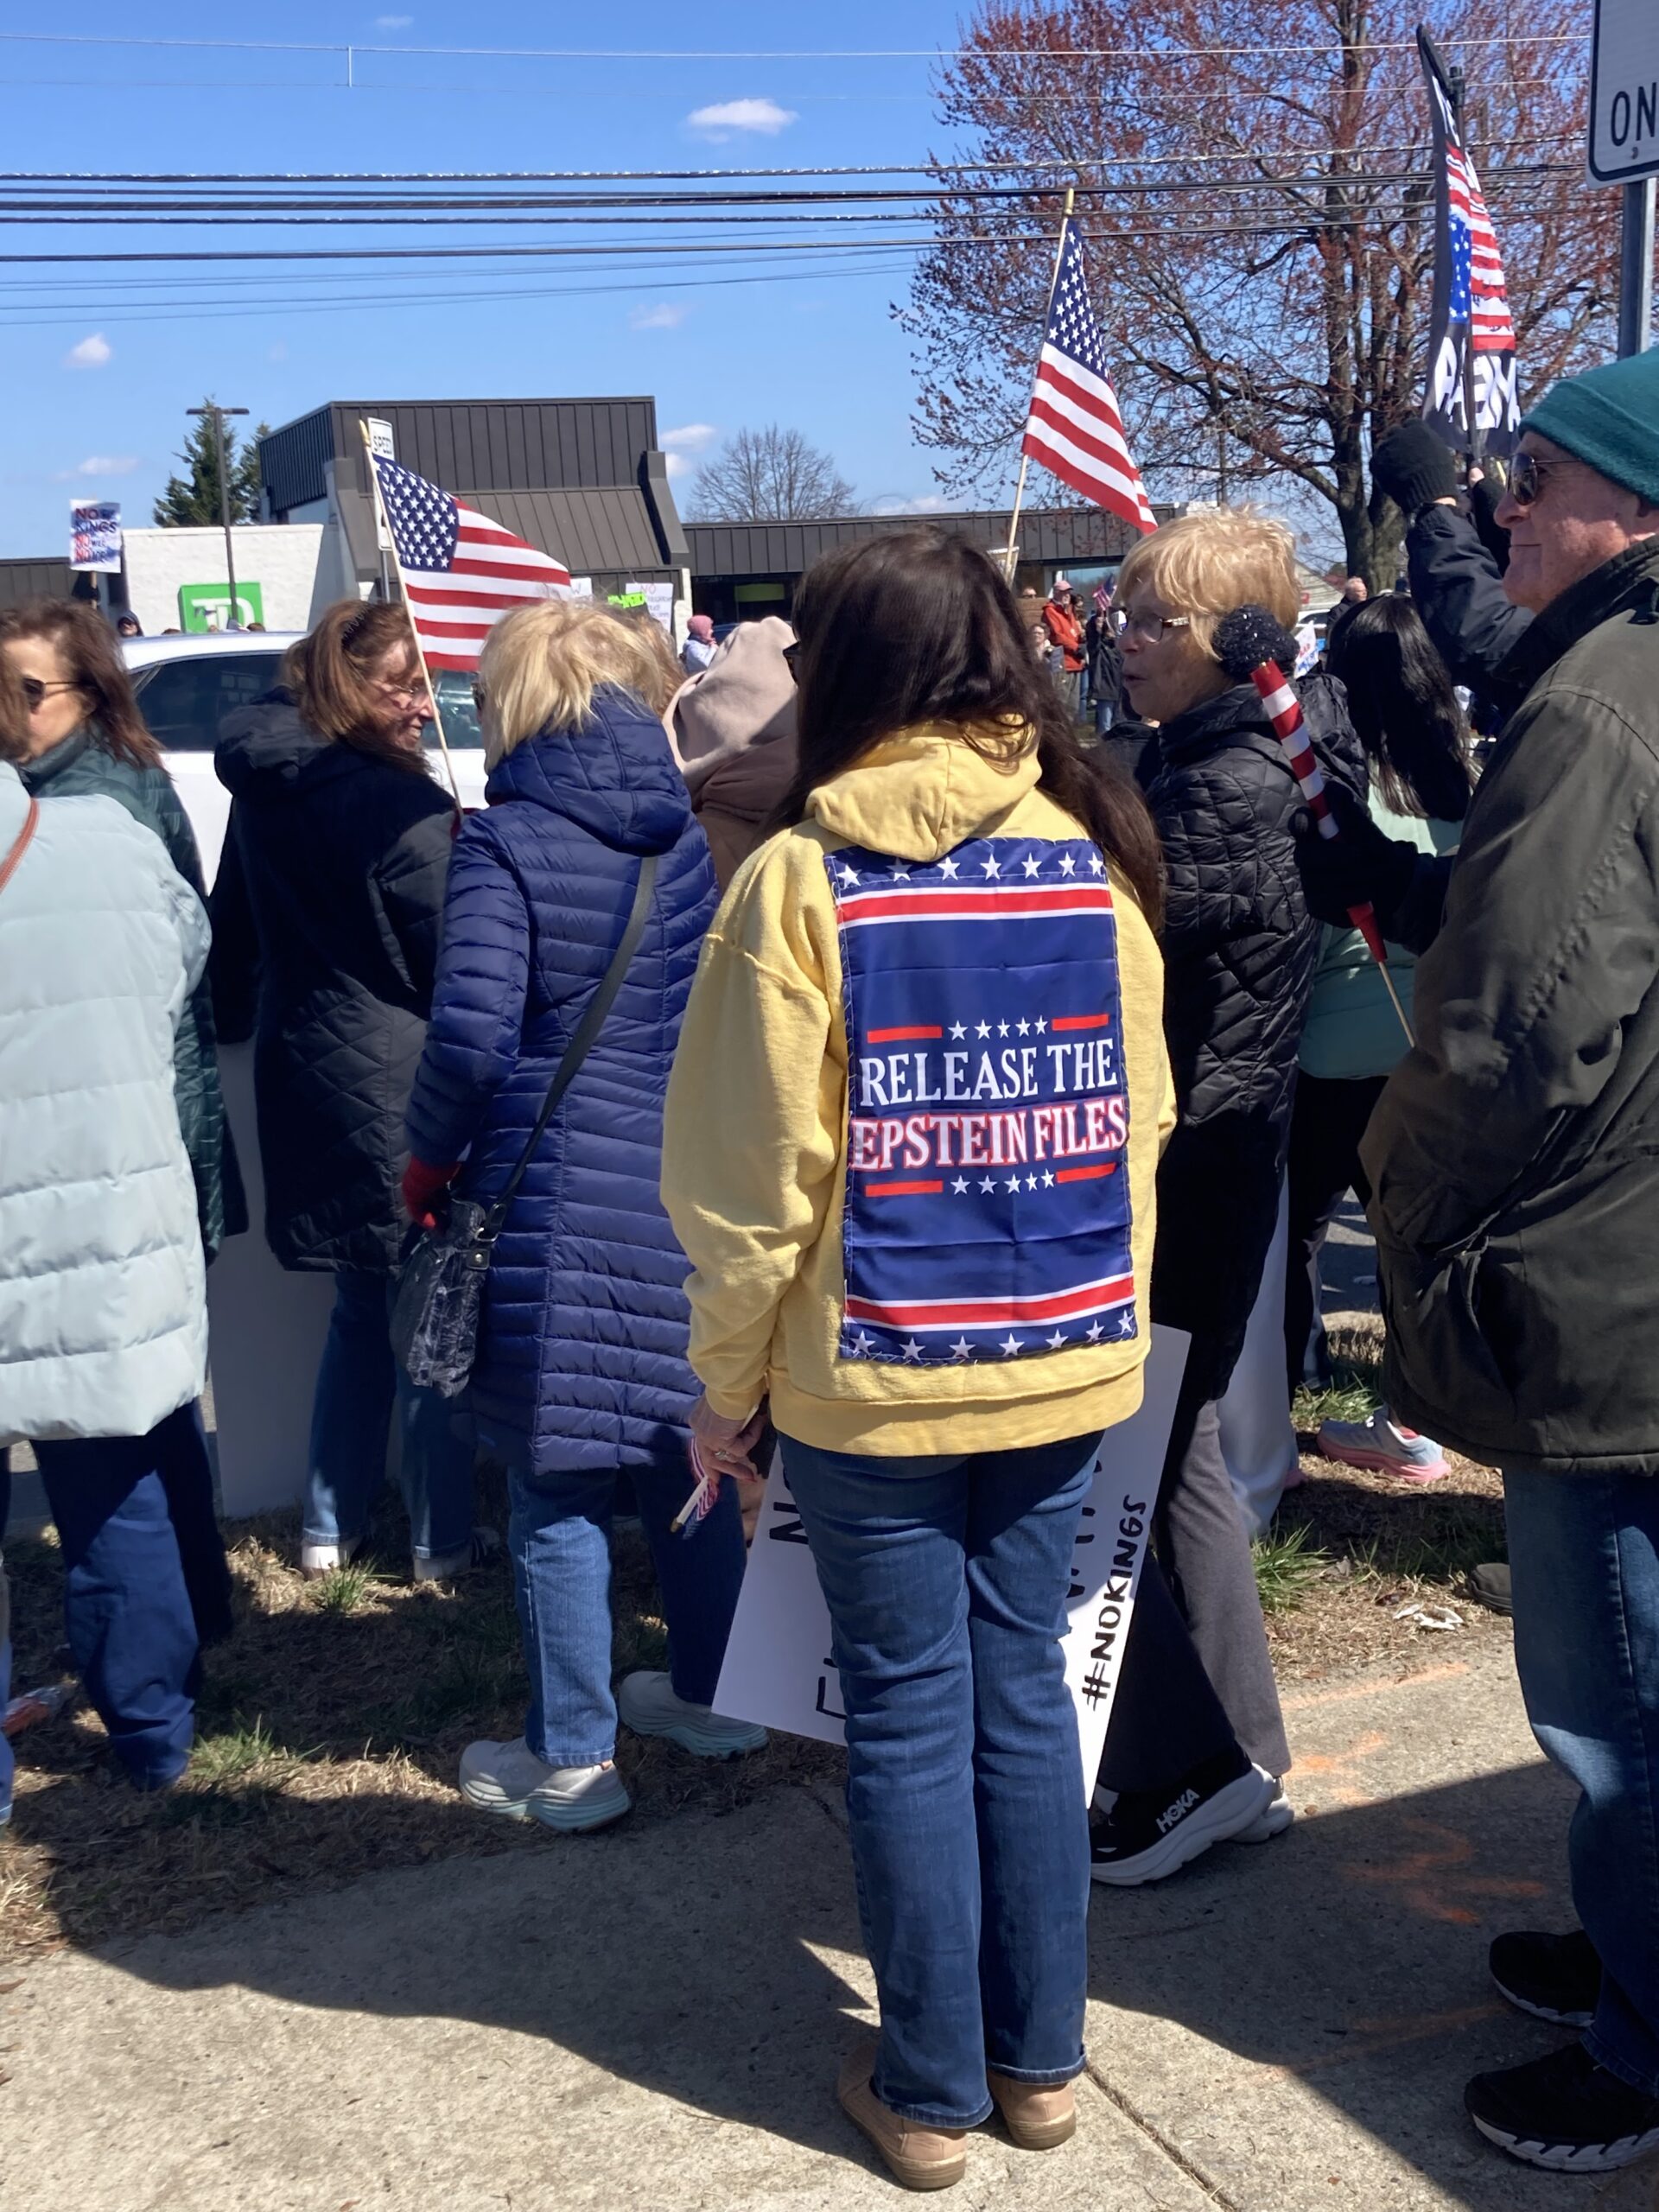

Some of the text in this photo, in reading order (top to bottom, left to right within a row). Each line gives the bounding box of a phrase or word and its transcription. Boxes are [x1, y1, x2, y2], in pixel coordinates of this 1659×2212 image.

[74, 519, 118, 533] KINGS
[75, 508, 99, 519] NO
[191, 598, 256, 631] TD
[859, 1039, 1117, 1107] RELEASE THE
[851, 1097, 1128, 1171] EPSTEIN FILES
[1081, 1494, 1147, 1713] #NOKINGS
[1155, 1787, 1201, 1834] HOKA
